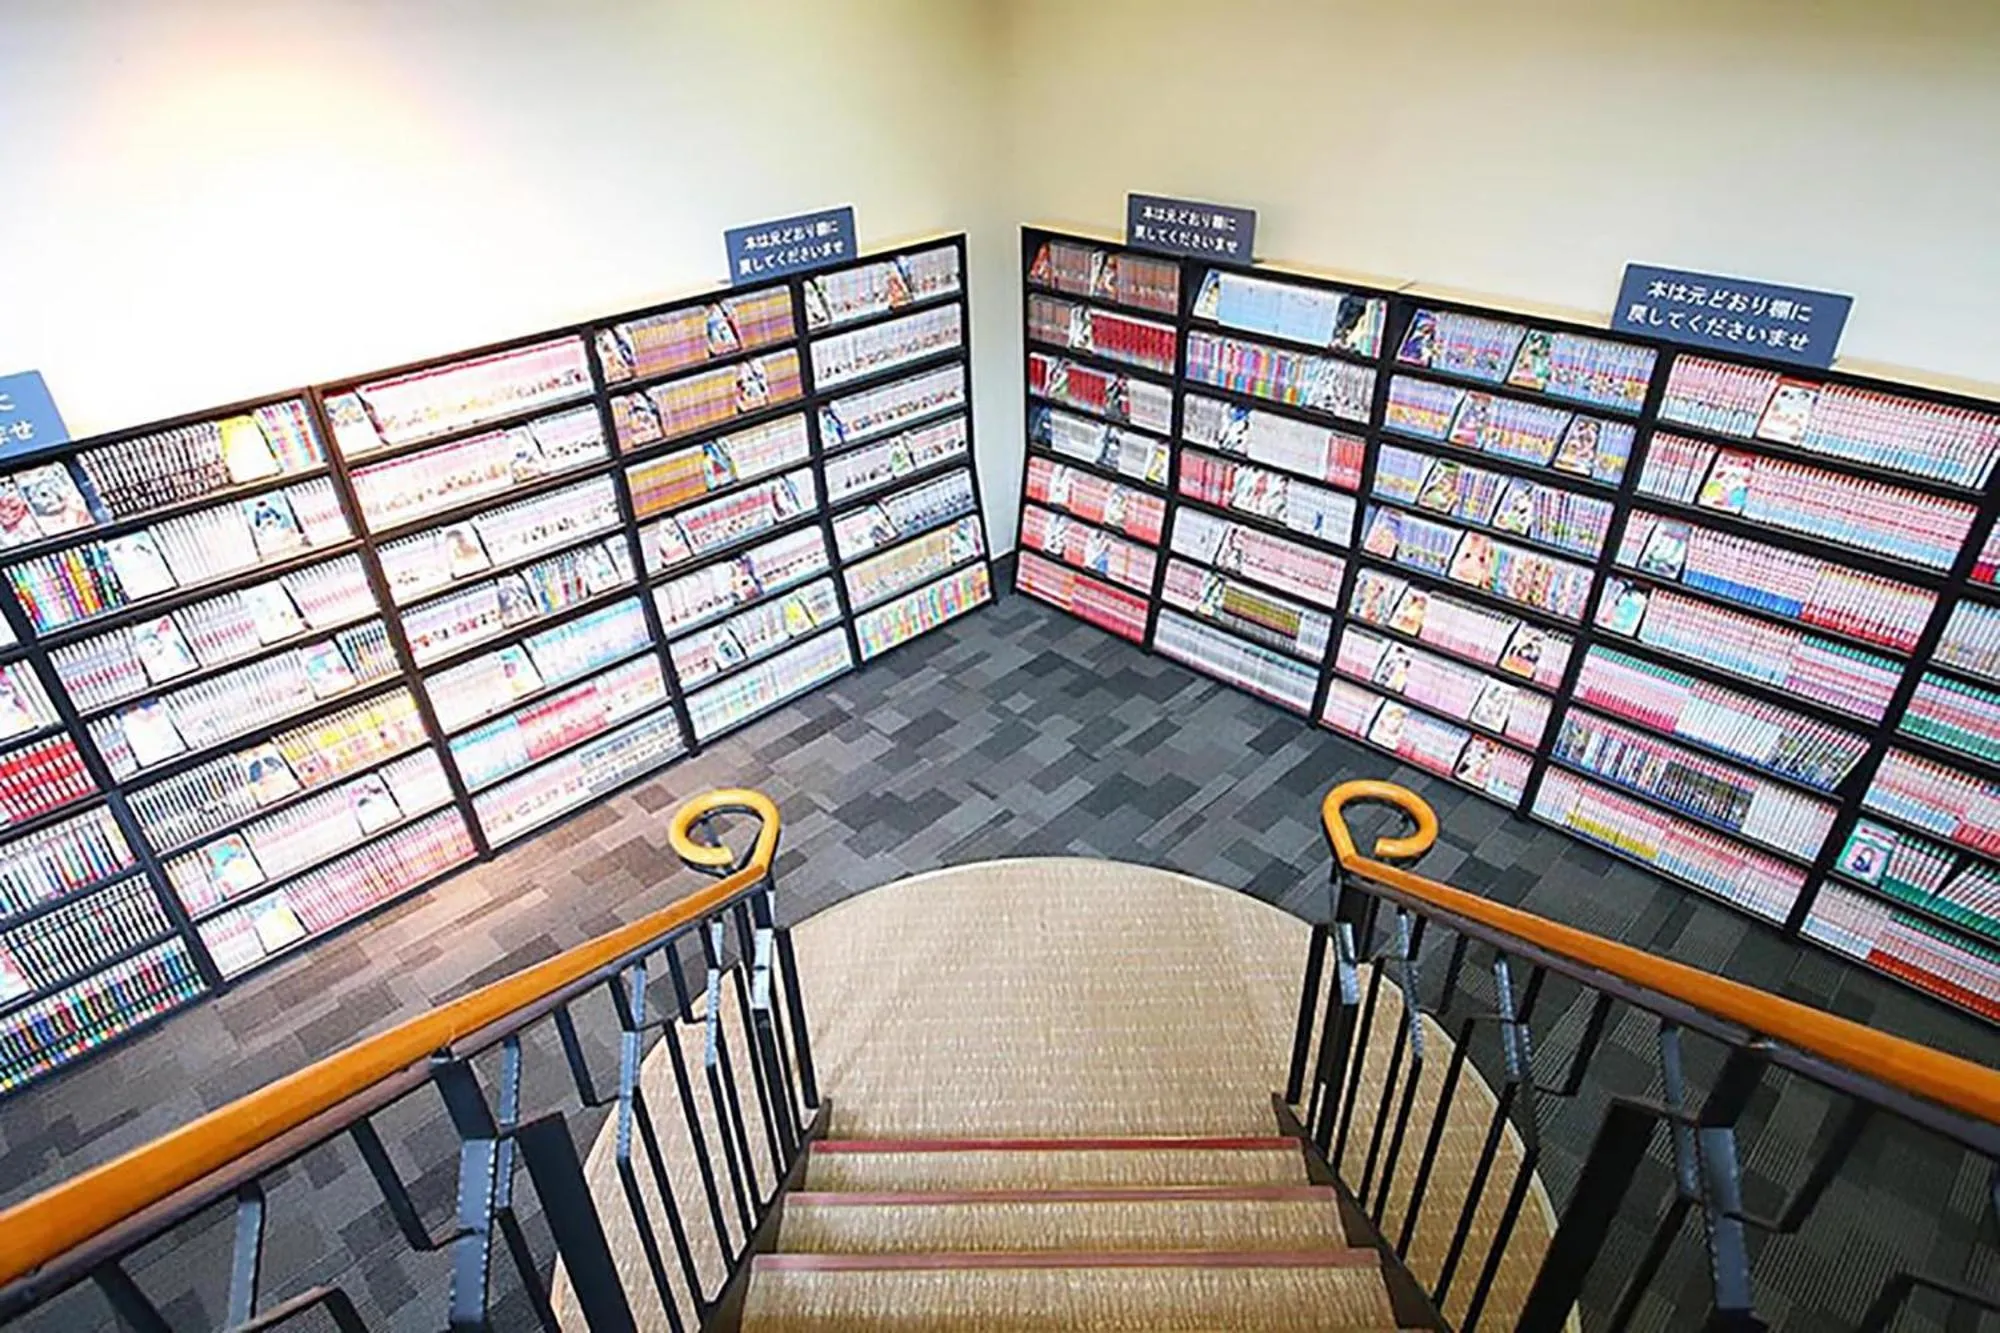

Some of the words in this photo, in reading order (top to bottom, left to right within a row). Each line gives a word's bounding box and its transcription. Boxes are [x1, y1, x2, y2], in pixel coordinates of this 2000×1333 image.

[1626, 303, 1810, 351] 戻してくださいませ
